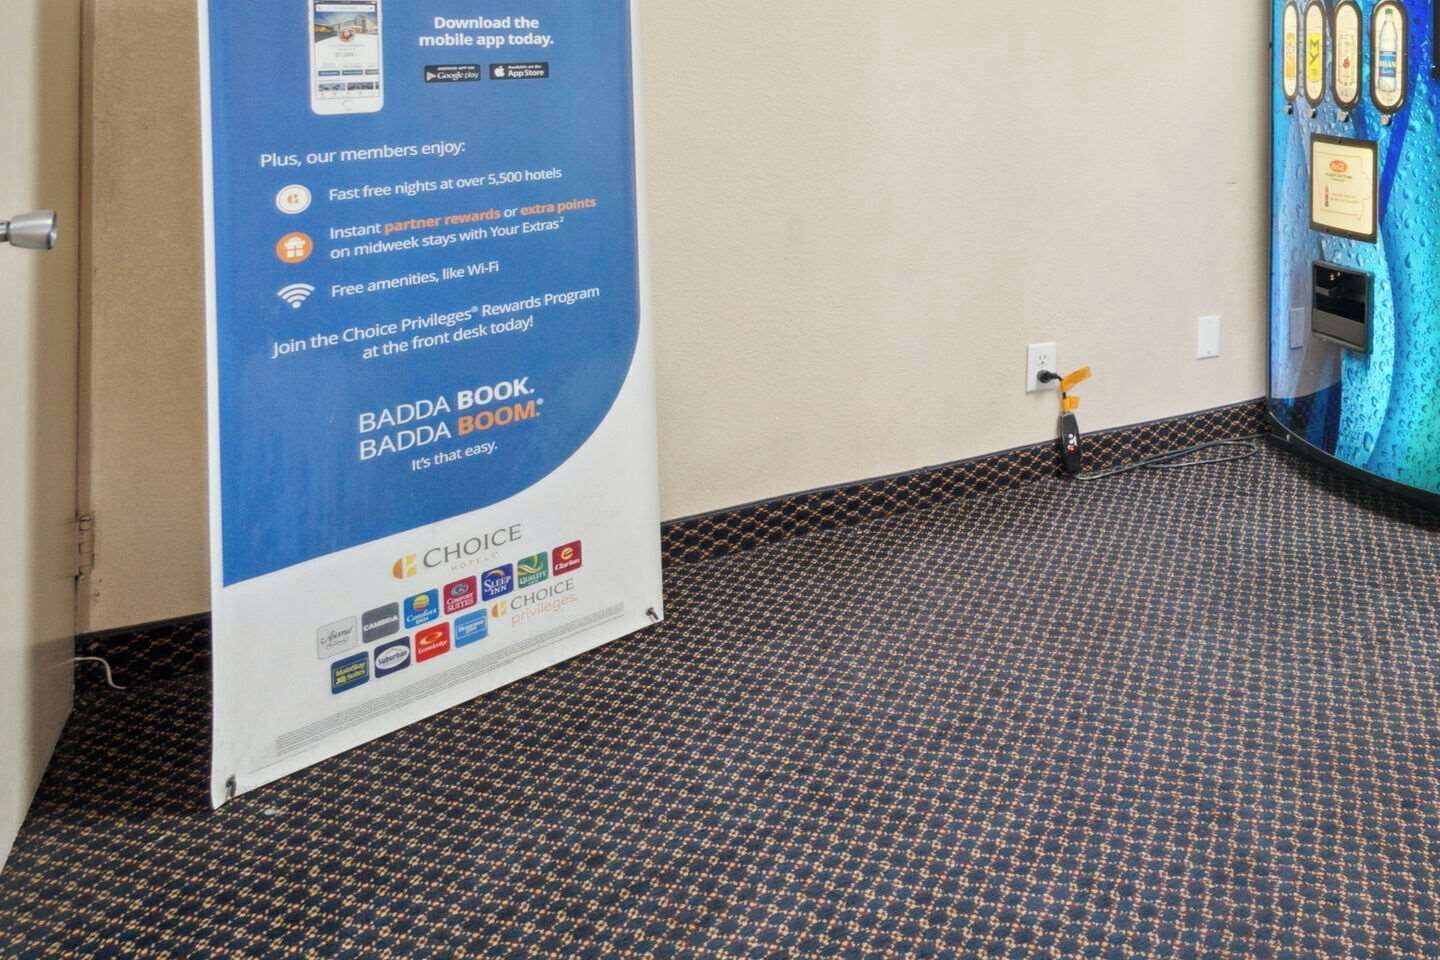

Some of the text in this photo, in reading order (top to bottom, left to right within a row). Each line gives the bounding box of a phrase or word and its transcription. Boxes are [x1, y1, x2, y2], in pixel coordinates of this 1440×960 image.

[419, 33, 555, 49] mobile app today.
[434, 16, 540, 30] Download the
[260, 141, 466, 168] Plus, our members enjoy:
[329, 167, 562, 201] Fast free nights at over 5,500 hotels
[329, 197, 597, 239] Instant partner rewards or extra points
[330, 246, 351, 259] on
[354, 236, 420, 256] midweek
[422, 232, 457, 249] stays
[459, 227, 488, 242] with
[491, 222, 520, 237] Your
[331, 261, 500, 298] Free amenities, like Wi-Fi
[271, 338, 307, 359] Join
[310, 332, 339, 350] the
[342, 322, 398, 344] Choice
[482, 296, 542, 318] Rewards
[544, 286, 600, 308] Program
[362, 316, 534, 360] at the front desk today!
[359, 377, 535, 433] BADDA BOOK.
[360, 422, 452, 461] BADDA
[411, 442, 498, 471] It's that easy.
[423, 524, 522, 569] CHOICE
[511, 578, 575, 609] CHOICE
